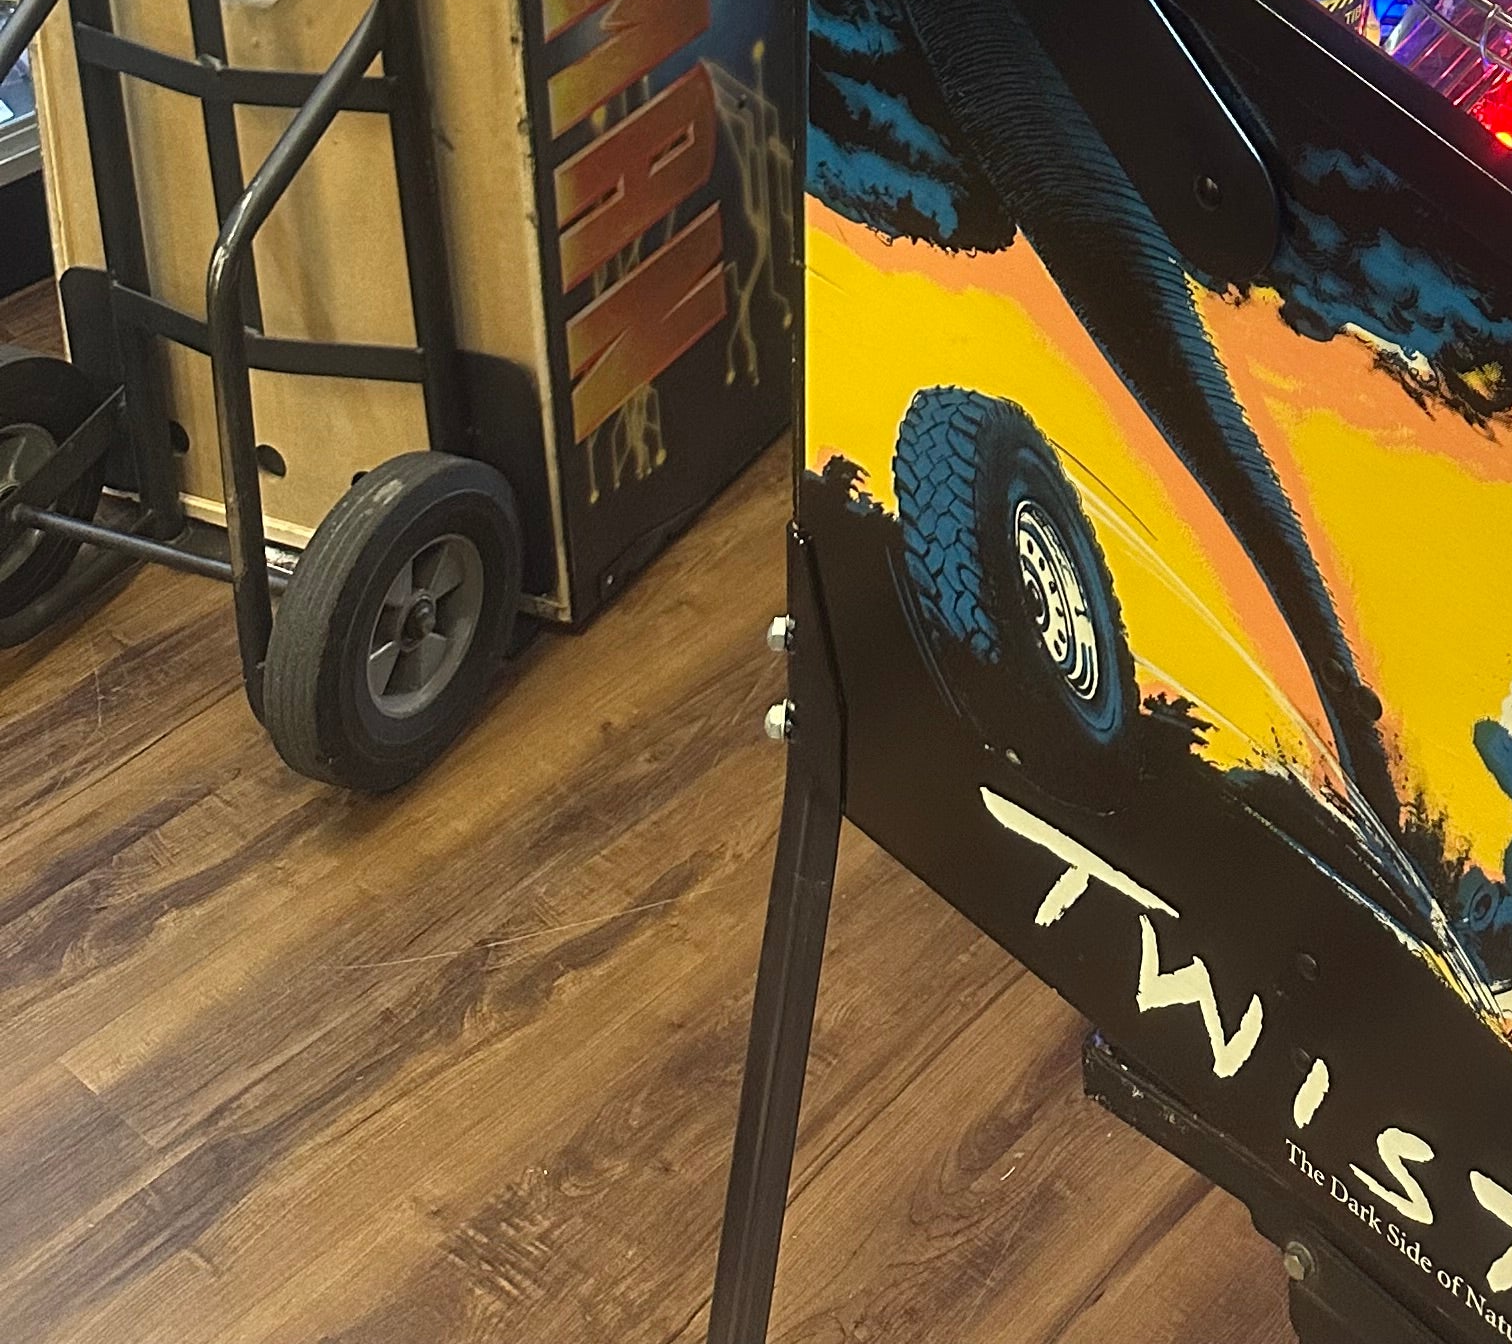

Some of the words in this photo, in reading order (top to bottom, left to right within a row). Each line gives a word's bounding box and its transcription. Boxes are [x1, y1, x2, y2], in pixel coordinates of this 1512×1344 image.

[1285, 1138, 1325, 1186] The
[1330, 1175, 1382, 1235] Dark
[1386, 1223, 1432, 1274] Side
[1437, 1268, 1465, 1297] of
